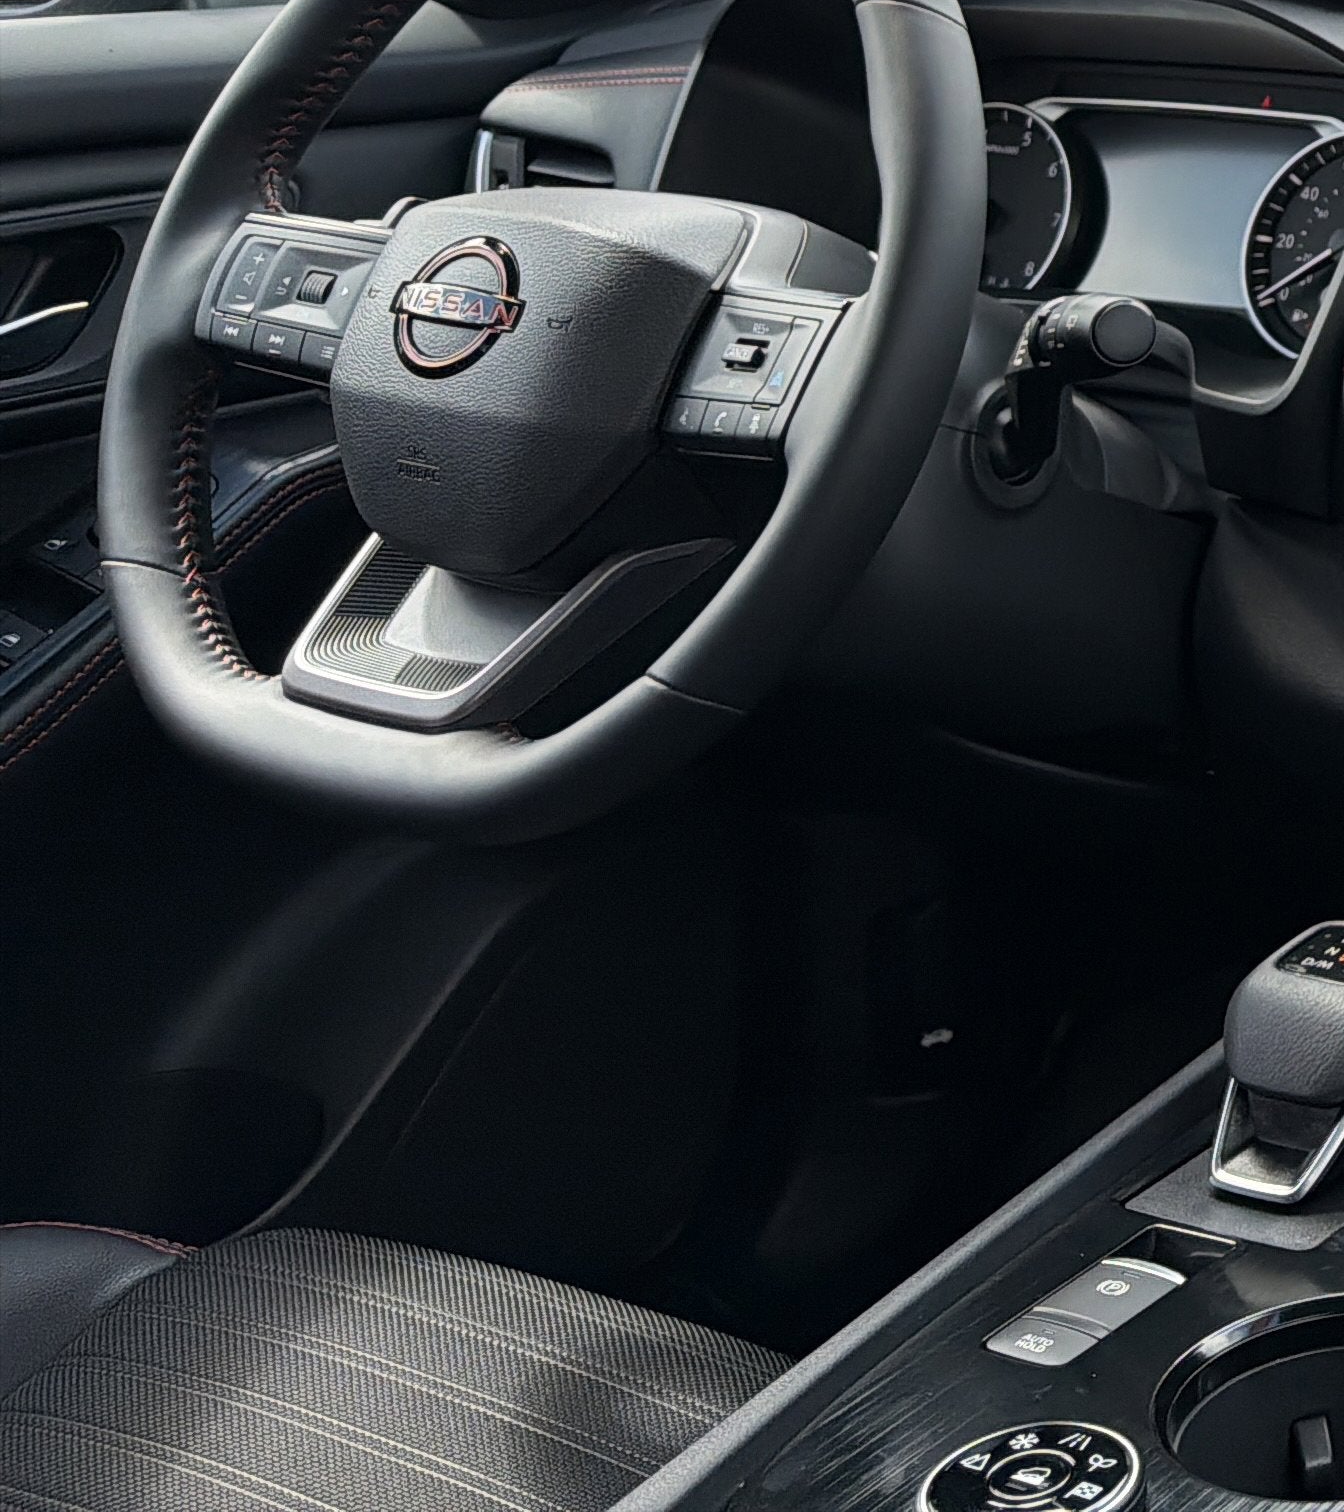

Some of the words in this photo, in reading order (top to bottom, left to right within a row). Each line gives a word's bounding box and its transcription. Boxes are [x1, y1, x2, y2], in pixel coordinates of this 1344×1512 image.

[1047, 162, 1058, 178] 6
[1300, 186, 1319, 201] 40
[1052, 212, 1062, 227] 7
[1276, 233, 1295, 249] 20
[1024, 261, 1035, 277] 8
[397, 288, 519, 327] NISSAN
[1323, 946, 1341, 956] N
[1301, 956, 1334, 970] D/M
[1014, 1340, 1047, 1353] HOLD
[1021, 1332, 1055, 1347] AUTO
